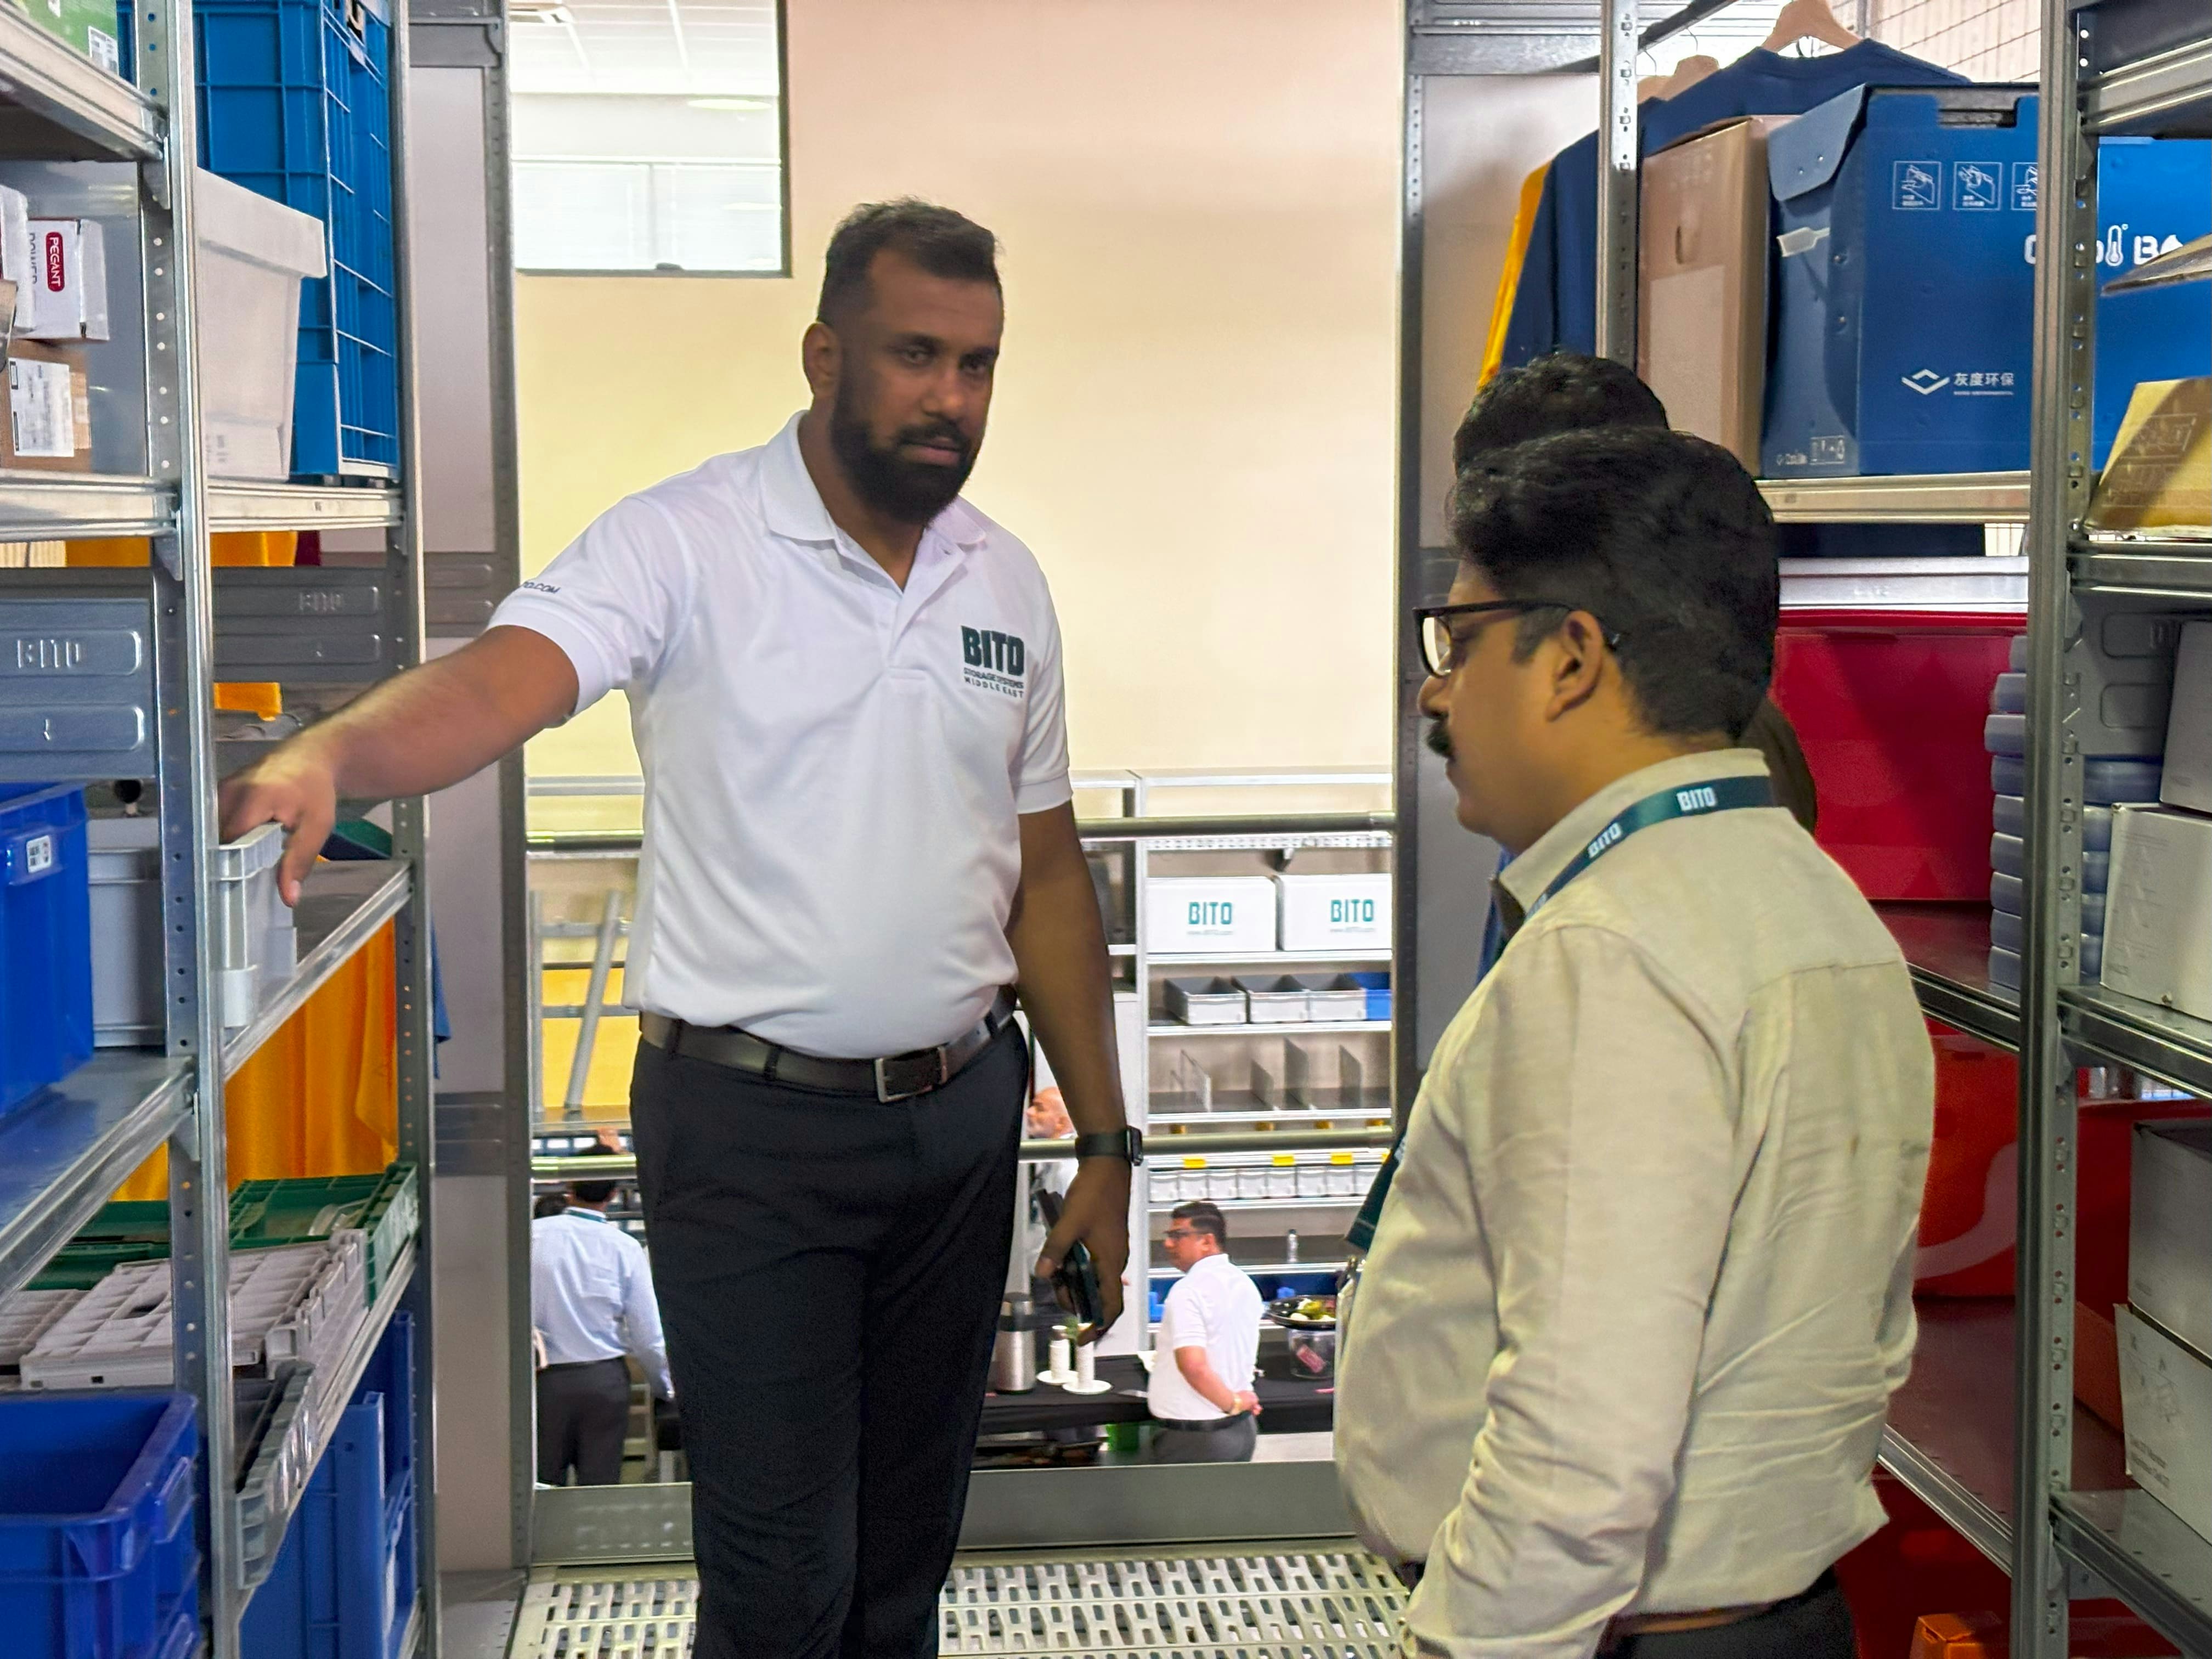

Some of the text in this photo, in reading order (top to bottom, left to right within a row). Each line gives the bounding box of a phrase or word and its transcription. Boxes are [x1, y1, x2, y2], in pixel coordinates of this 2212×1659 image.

[49, 236, 61, 286] PEGANT
[961, 625, 1024, 676] BITO
[963, 675, 1024, 698] MIDDLE EAST
[1676, 786, 1717, 811] BITO
[1587, 822, 1622, 858] BITO
[1188, 901, 1233, 926] BITO
[1330, 899, 1375, 922] BITO
